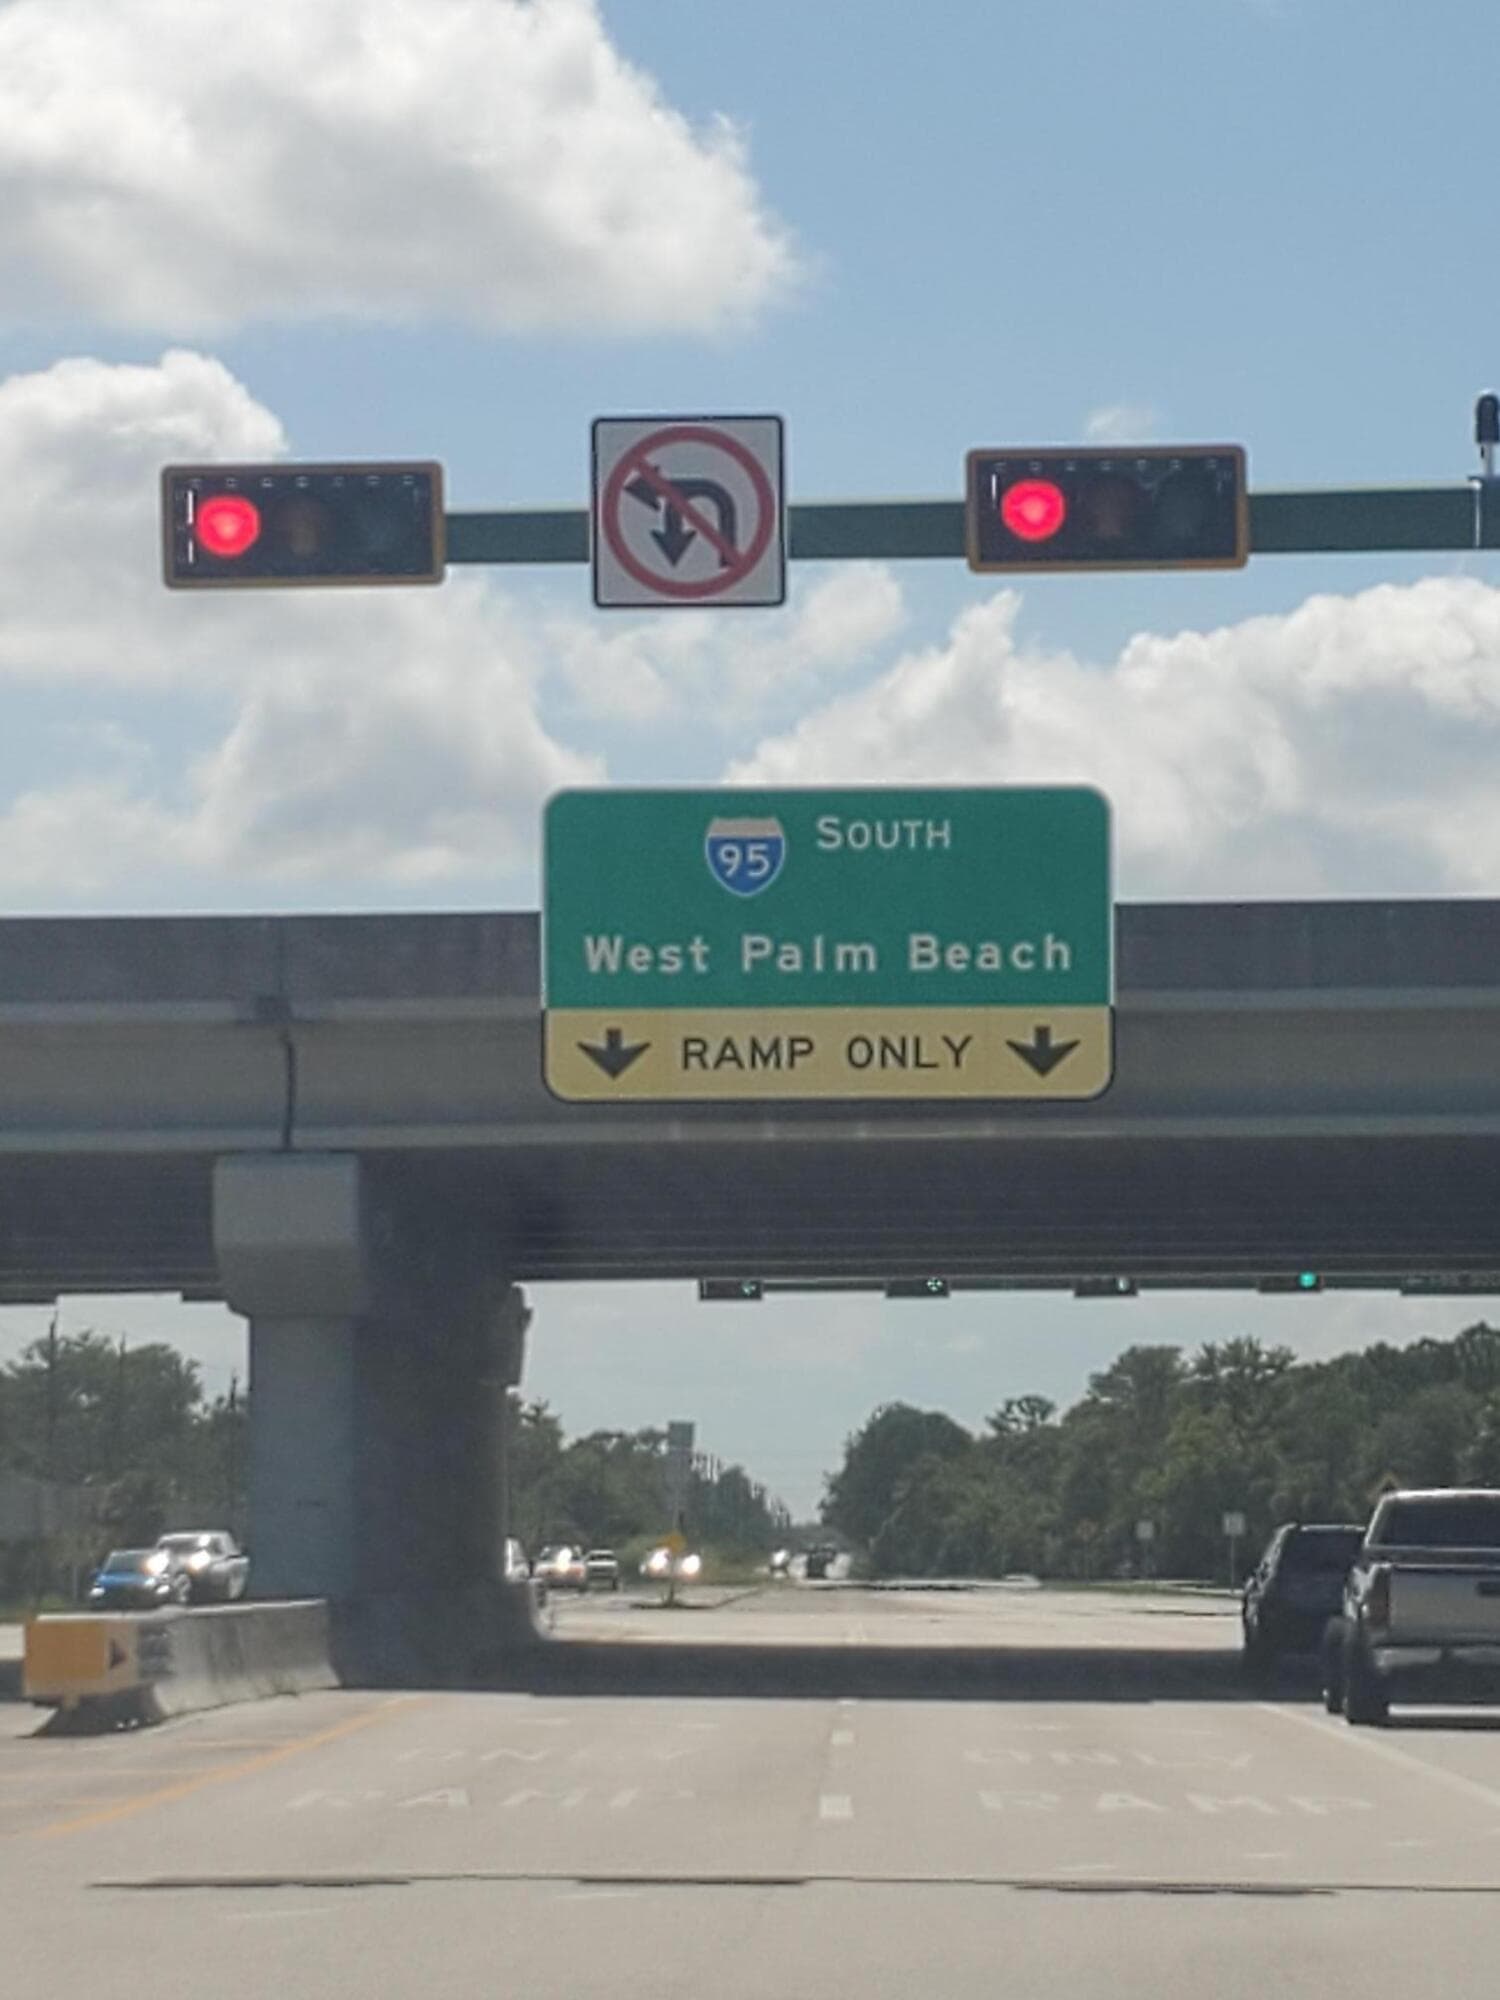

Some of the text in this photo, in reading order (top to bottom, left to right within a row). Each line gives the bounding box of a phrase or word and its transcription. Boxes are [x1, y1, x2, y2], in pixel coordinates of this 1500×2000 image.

[815, 816, 952, 850] SOUTH
[718, 844, 771, 879] 95
[583, 932, 1072, 973] West Palm Beach
[682, 1035, 974, 1070] RAMP ONLY
